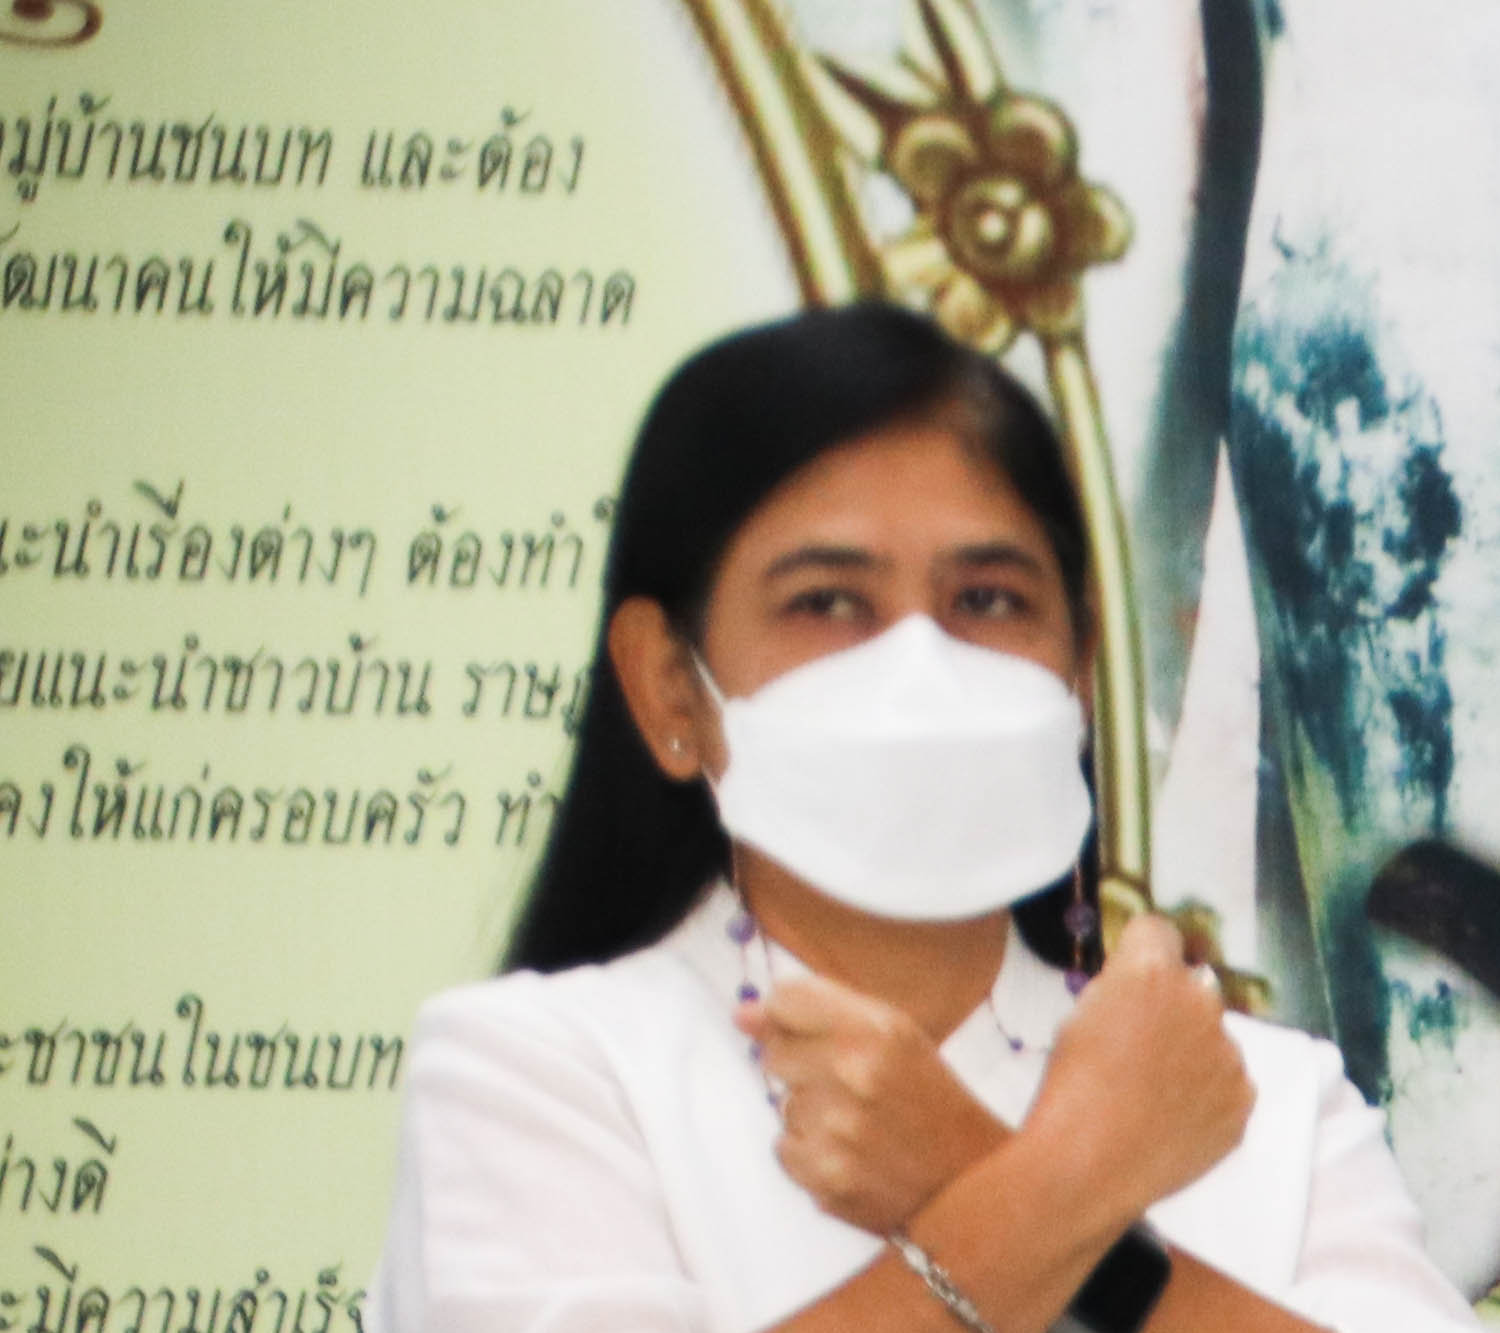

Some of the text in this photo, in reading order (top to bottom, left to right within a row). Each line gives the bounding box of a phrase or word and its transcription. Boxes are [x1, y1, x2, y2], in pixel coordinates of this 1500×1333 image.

[0, 93, 585, 204] มู่บ้านชนบท และต้อง
[0, 480, 378, 596] ะนำเรื่องต่างๆ
